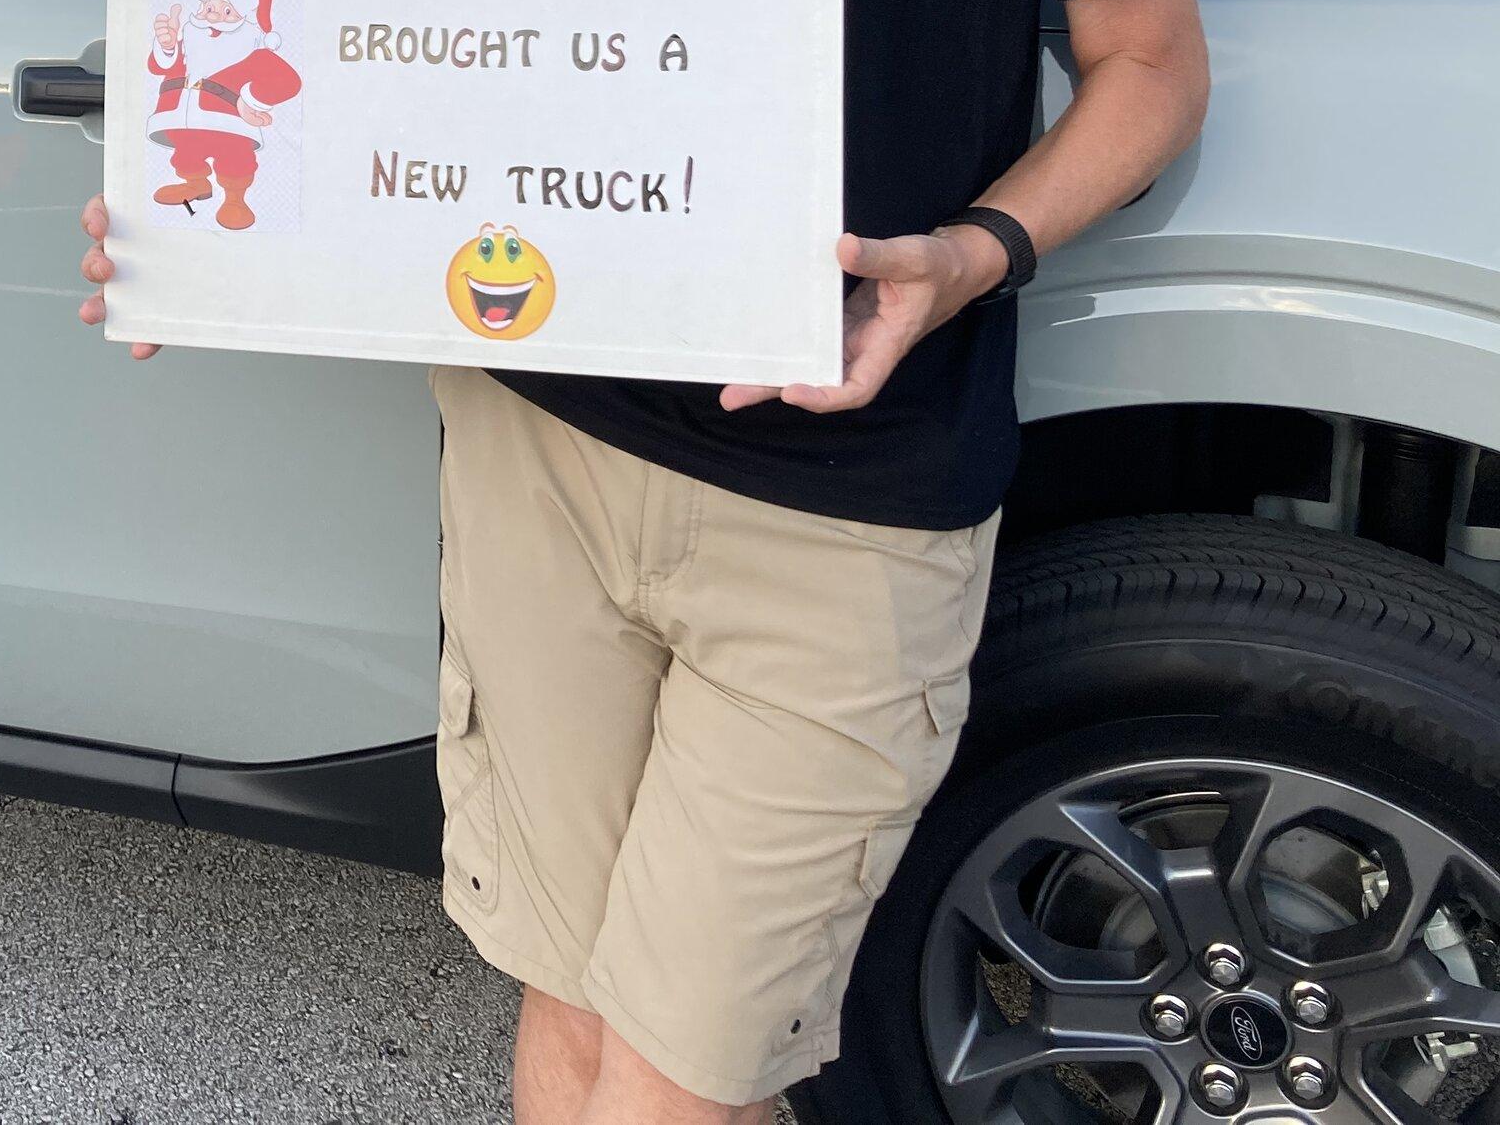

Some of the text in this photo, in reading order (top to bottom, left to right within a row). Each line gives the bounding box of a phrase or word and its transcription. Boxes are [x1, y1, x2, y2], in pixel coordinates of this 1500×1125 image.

[338, 23, 690, 72] BROUGHT US A
[369, 149, 695, 215] NEW TRUCK!
[1234, 1016, 1258, 1051] Ford
